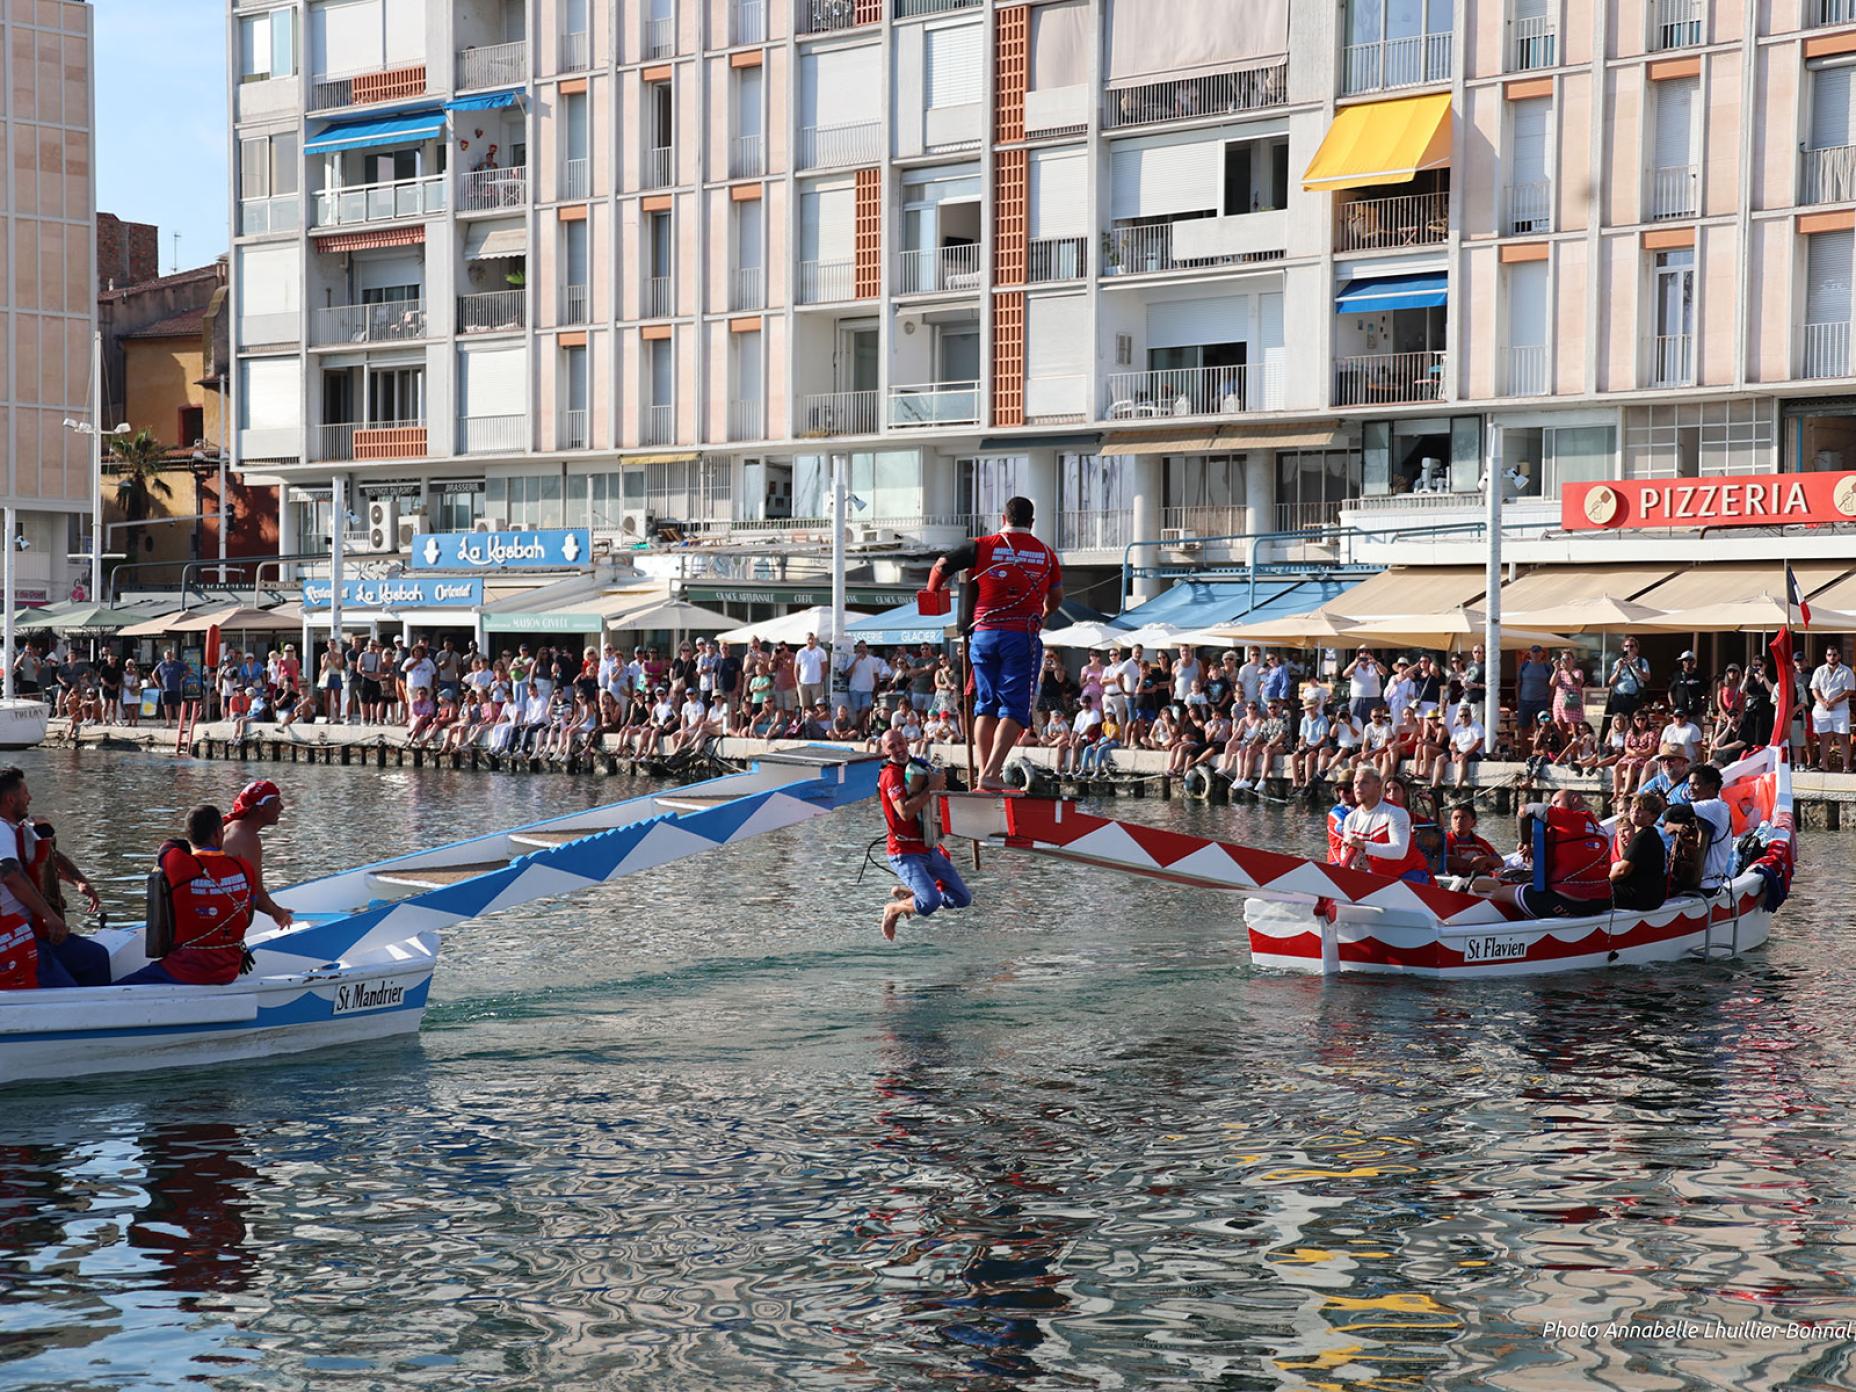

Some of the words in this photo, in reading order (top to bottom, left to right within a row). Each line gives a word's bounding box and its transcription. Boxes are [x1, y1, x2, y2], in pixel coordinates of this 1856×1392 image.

[445, 483, 479, 493] BRASSERIE
[639, 482, 809, 519] PIZZERIA
[457, 536, 487, 565] La
[487, 535, 545, 564] Kasbah
[355, 584, 380, 604] La
[379, 583, 424, 604] Kasbah
[900, 631, 938, 642] GLACIER
[1467, 939, 1480, 959] St
[1484, 937, 1525, 958] Flavien
[336, 985, 350, 1011] St
[352, 980, 404, 1009] Mandrier
